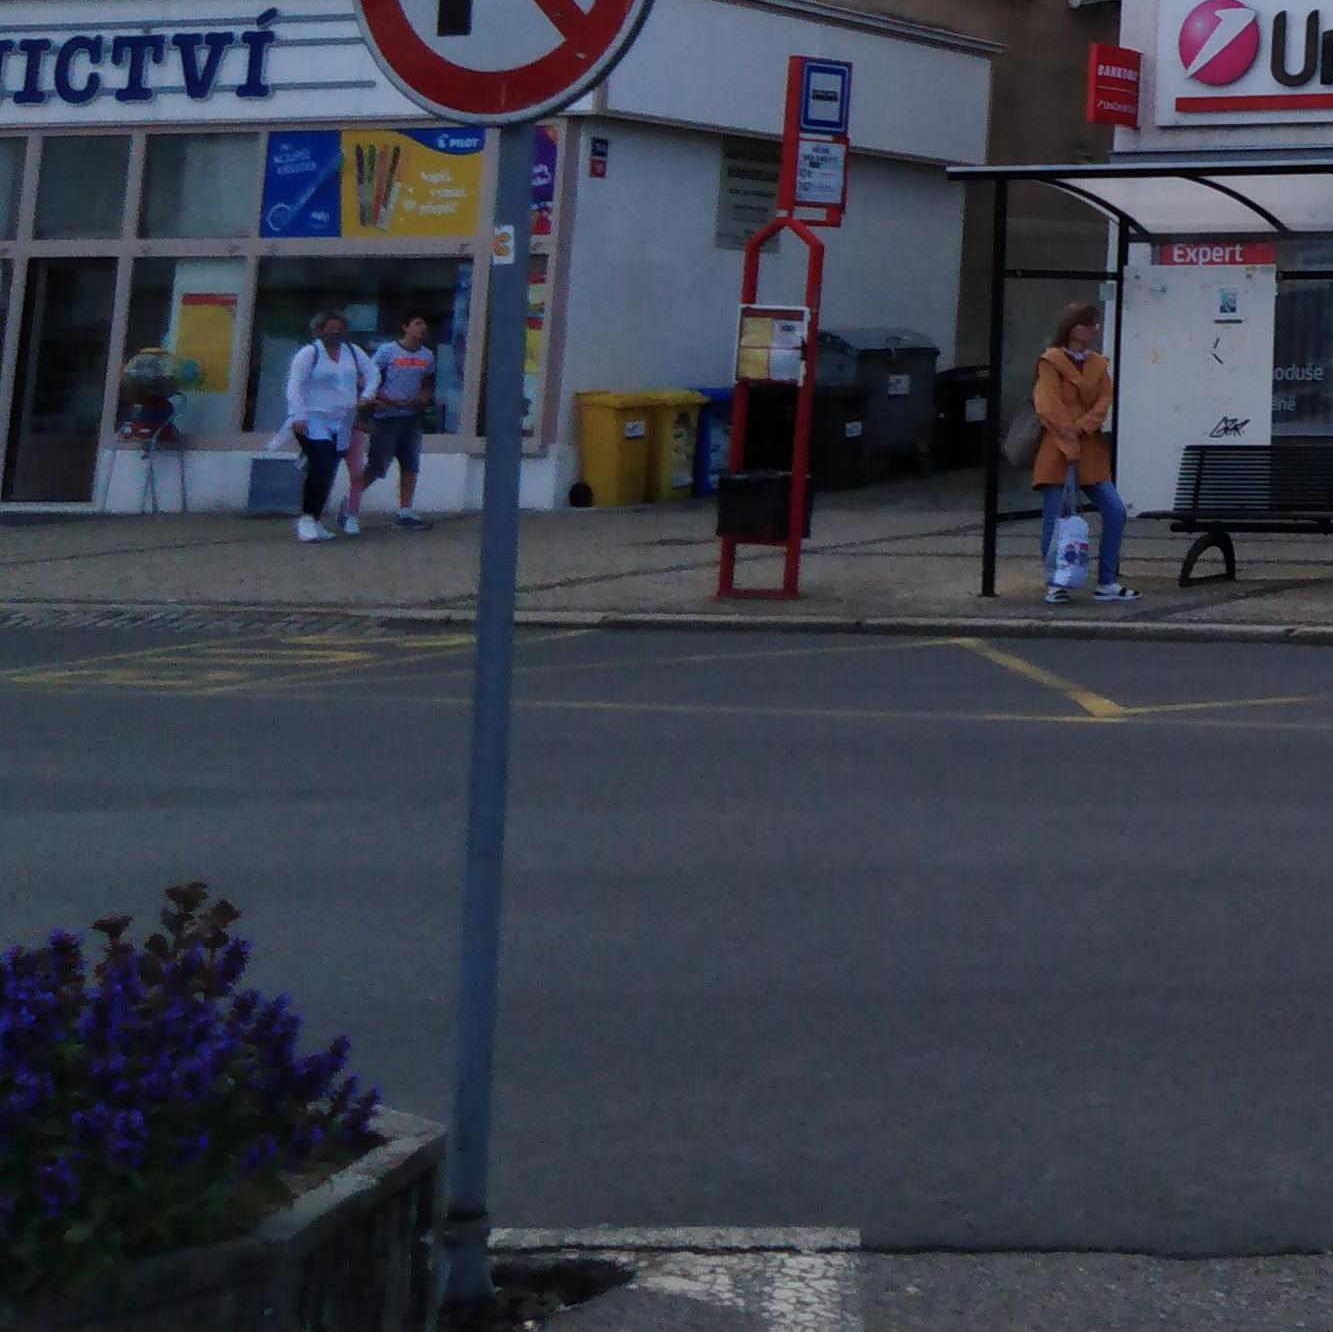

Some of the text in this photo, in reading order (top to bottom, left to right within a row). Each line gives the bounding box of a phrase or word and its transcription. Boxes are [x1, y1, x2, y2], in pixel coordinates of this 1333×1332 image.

[0, 6, 278, 104] ICTVÍ
[448, 137, 480, 148] PILOT
[1172, 244, 1244, 264] Expert
[1273, 361, 1325, 381] oduše
